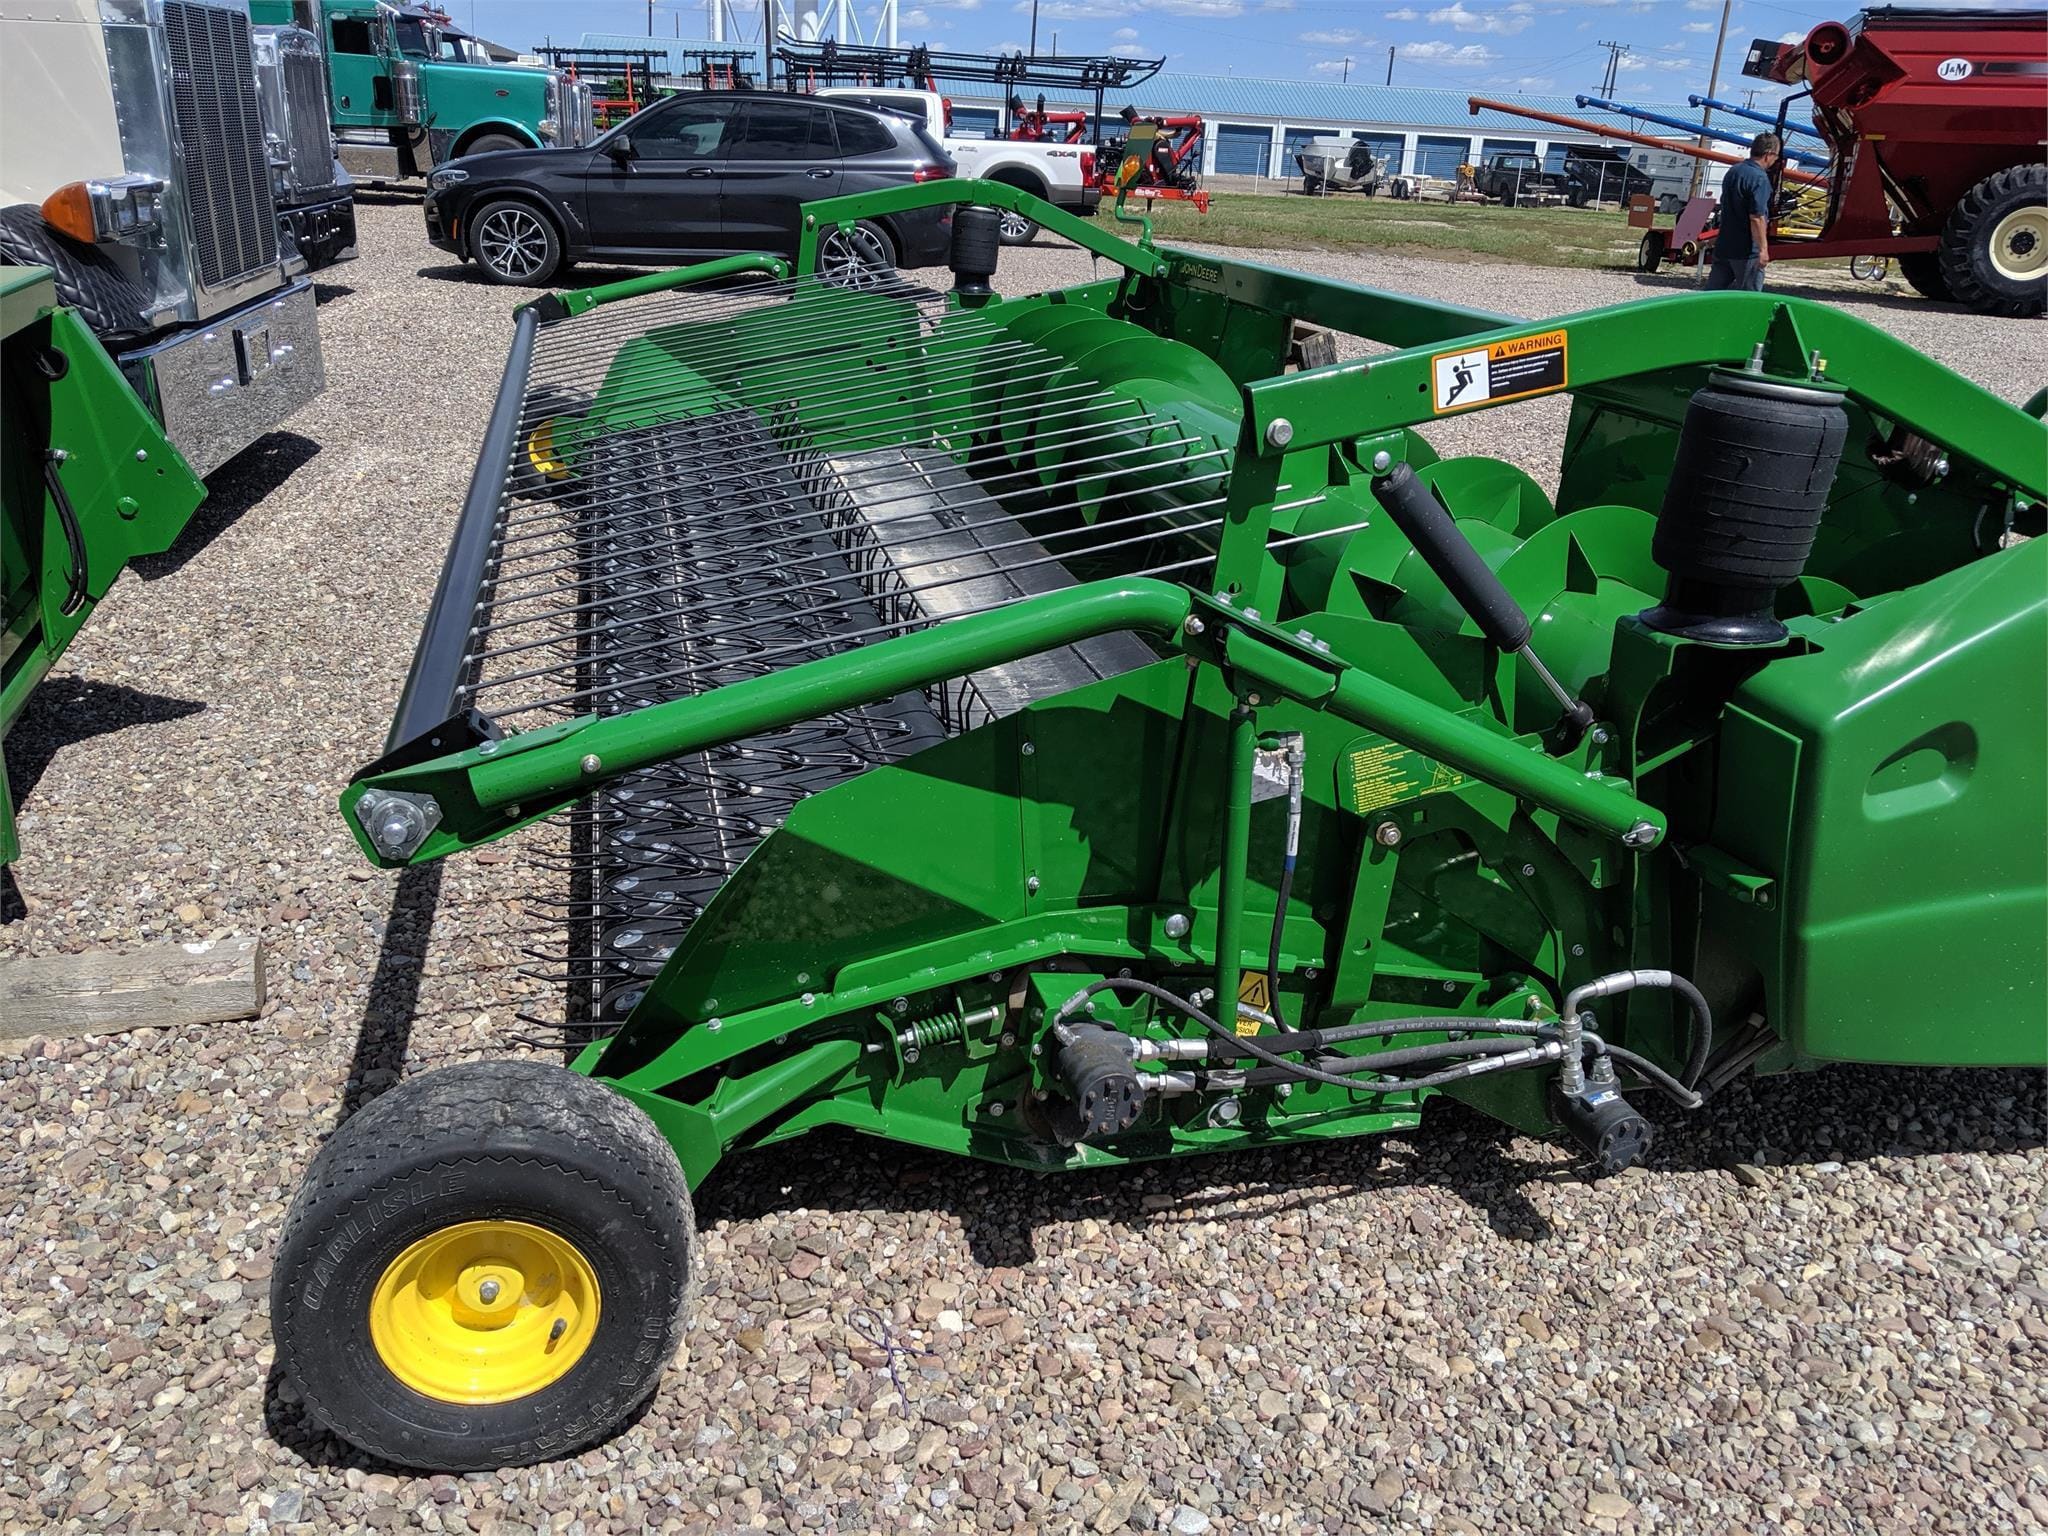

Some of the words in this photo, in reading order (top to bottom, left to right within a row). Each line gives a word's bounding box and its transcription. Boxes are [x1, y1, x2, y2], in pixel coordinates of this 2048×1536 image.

[1941, 63, 1967, 76] J&M
[1508, 334, 1562, 353] WARNING
[302, 1170, 467, 1310] CARLISLE
[618, 1315, 663, 1387] USA
